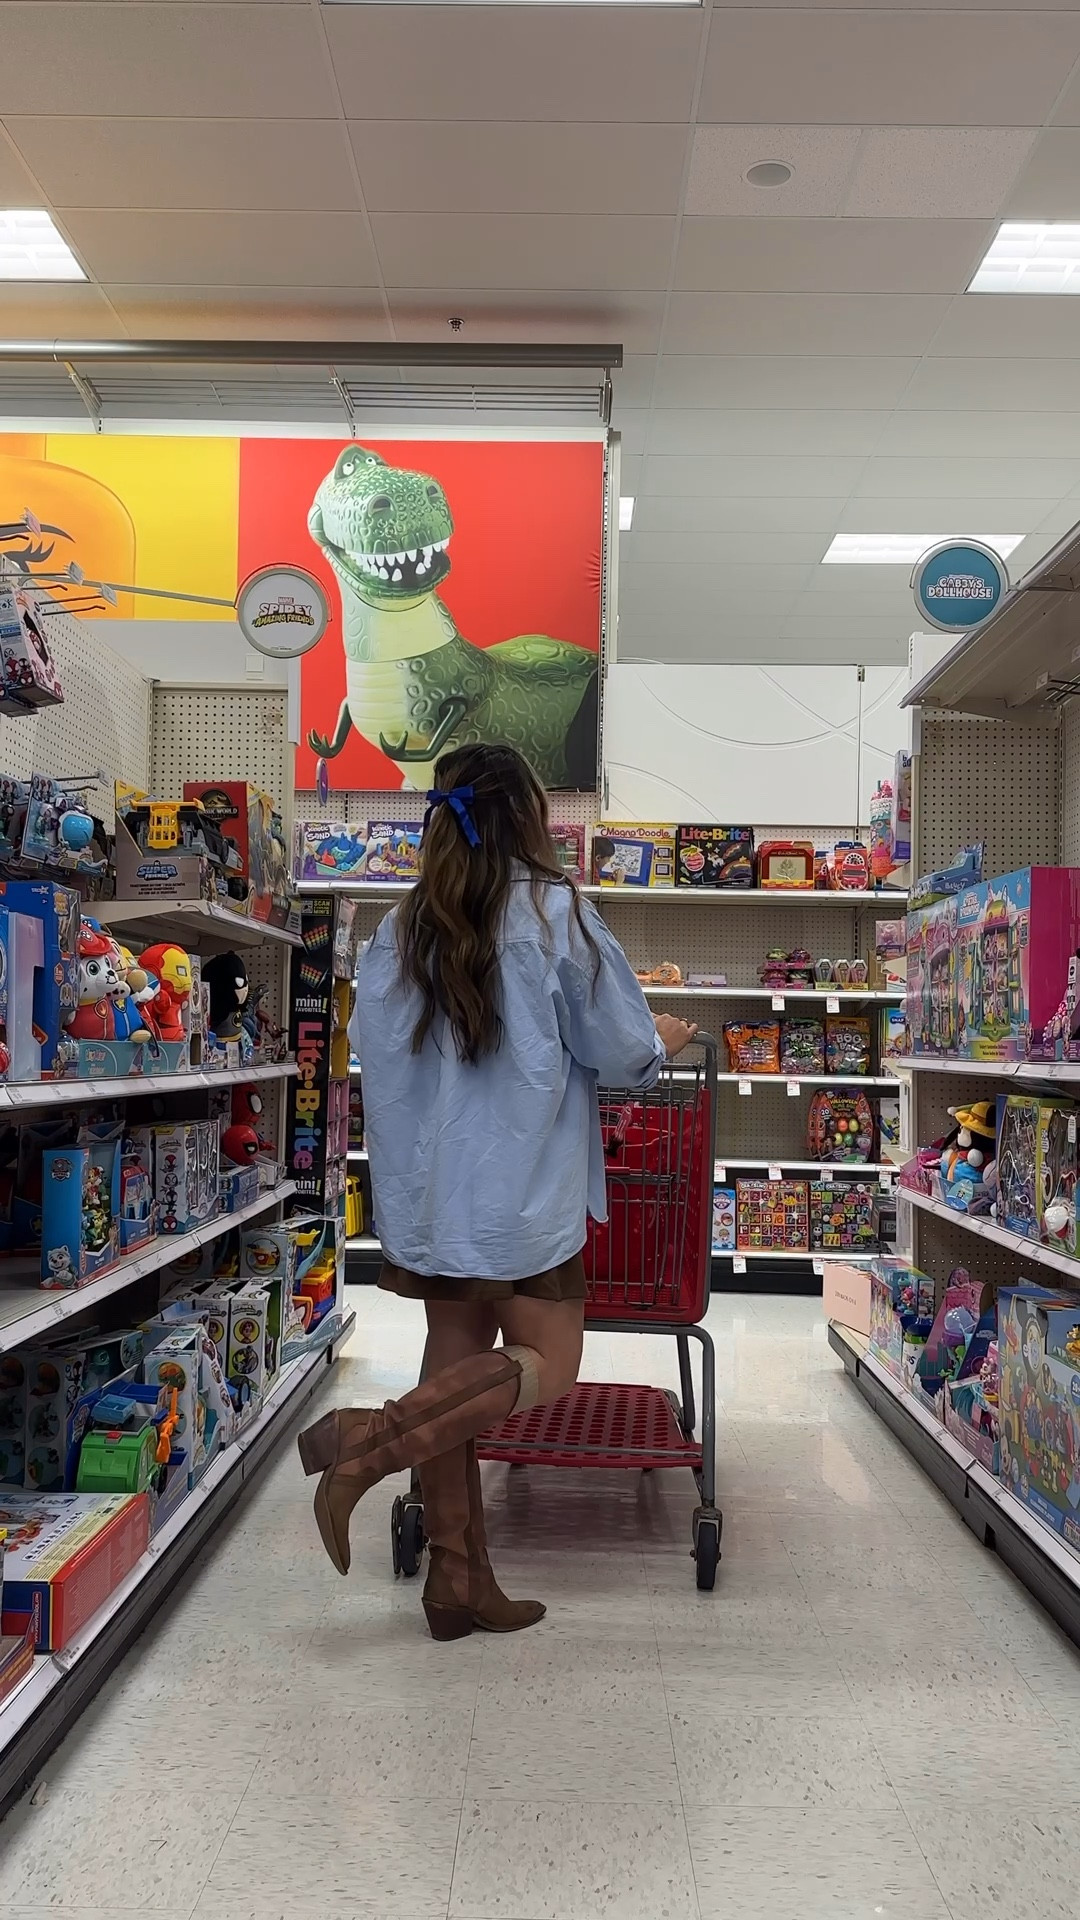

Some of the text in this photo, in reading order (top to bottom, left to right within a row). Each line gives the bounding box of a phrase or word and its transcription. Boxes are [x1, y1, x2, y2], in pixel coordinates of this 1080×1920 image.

[940, 578, 982, 588] GABBY'S
[928, 587, 992, 598] DOLLHOUSE
[259, 603, 312, 617] SPIDEY
[255, 614, 286, 627] AMAZING
[287, 614, 315, 625] FRIENDS
[306, 832, 331, 841] SAND
[371, 830, 394, 838] SAND
[636, 828, 671, 839] Doodle
[138, 866, 177, 875] SUPER
[836, 1033, 862, 1044] BOO
[763, 1214, 771, 1222] 15
